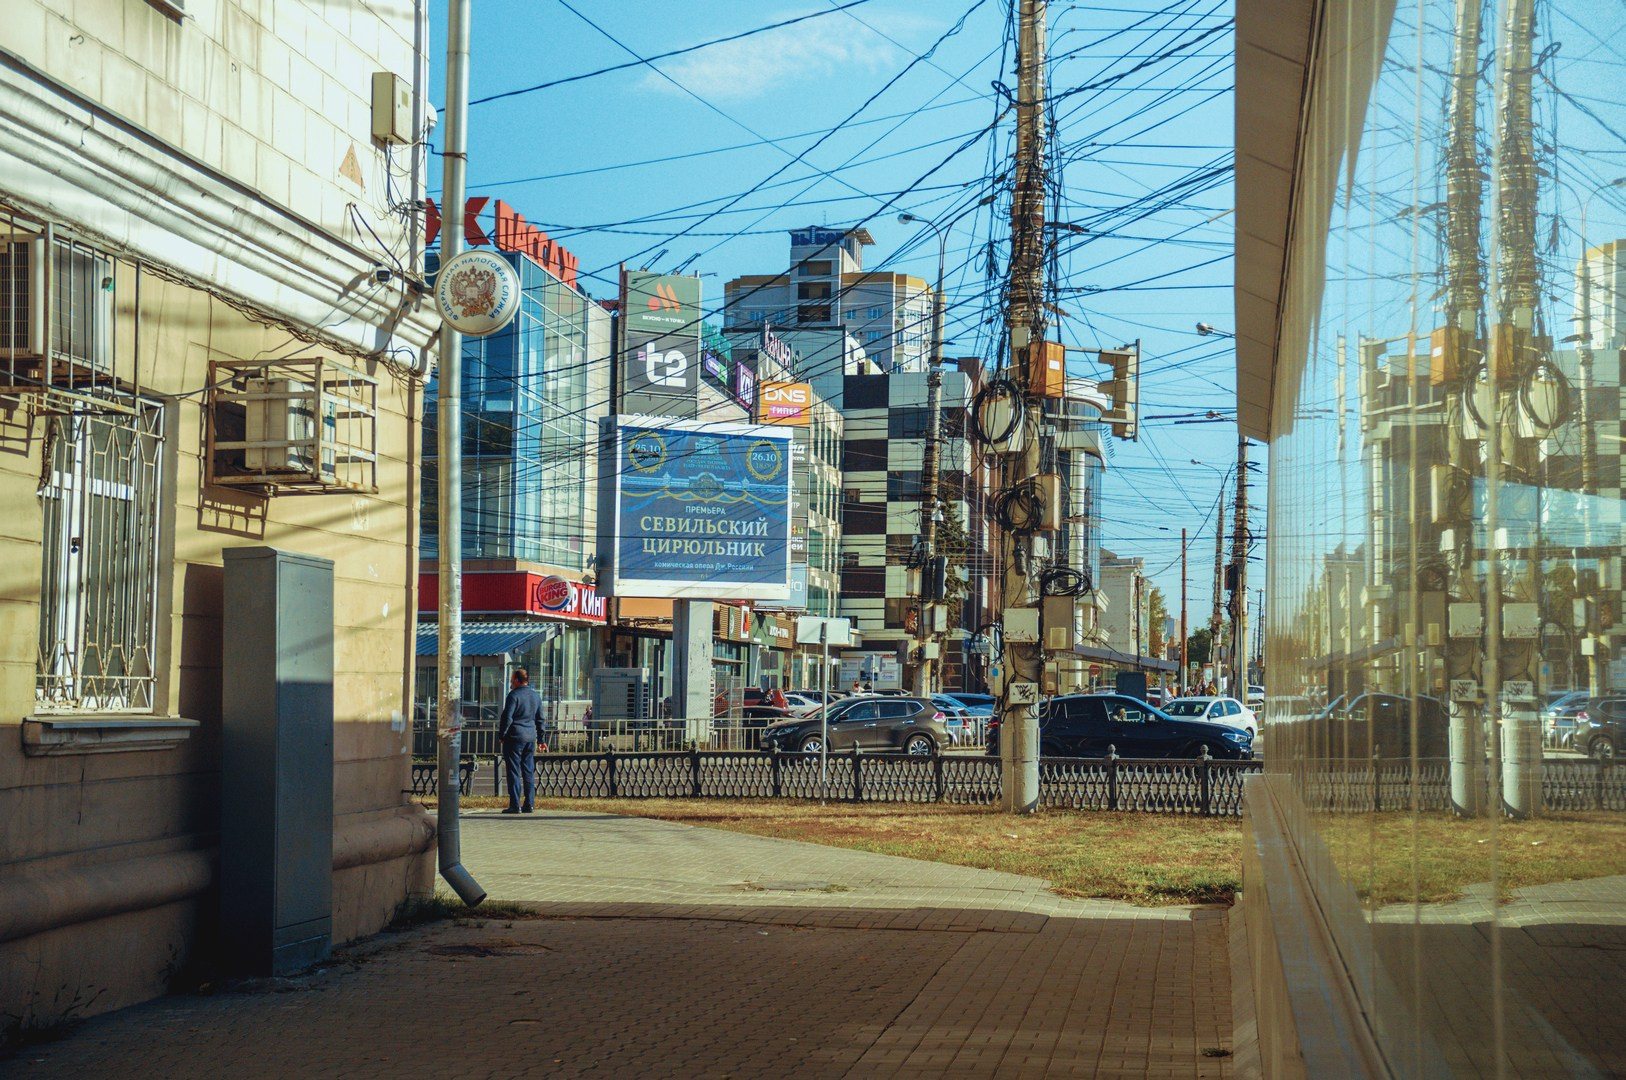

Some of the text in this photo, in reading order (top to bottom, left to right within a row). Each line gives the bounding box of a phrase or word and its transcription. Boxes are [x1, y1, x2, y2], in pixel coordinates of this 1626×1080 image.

[494, 199, 579, 291] ПАССАЖ
[440, 257, 510, 321] ФЕДЕРАЛЬНАЯ НАЛОГОВАЯ СЛУЖБА
[646, 342, 687, 388] t2
[764, 387, 806, 403] DNS
[772, 406, 799, 416] ГИПЕР
[752, 453, 777, 462] 26.10
[685, 505, 726, 515] ПРЕМЬЕРА
[640, 516, 769, 536] СЕВИЛЬСКИЙ
[642, 538, 766, 557] ЦИРЮЛЬНИК
[654, 561, 694, 569] комическая
[540, 581, 567, 595] BURGER
[540, 587, 568, 602] KING
[581, 588, 606, 617] КИНГ
